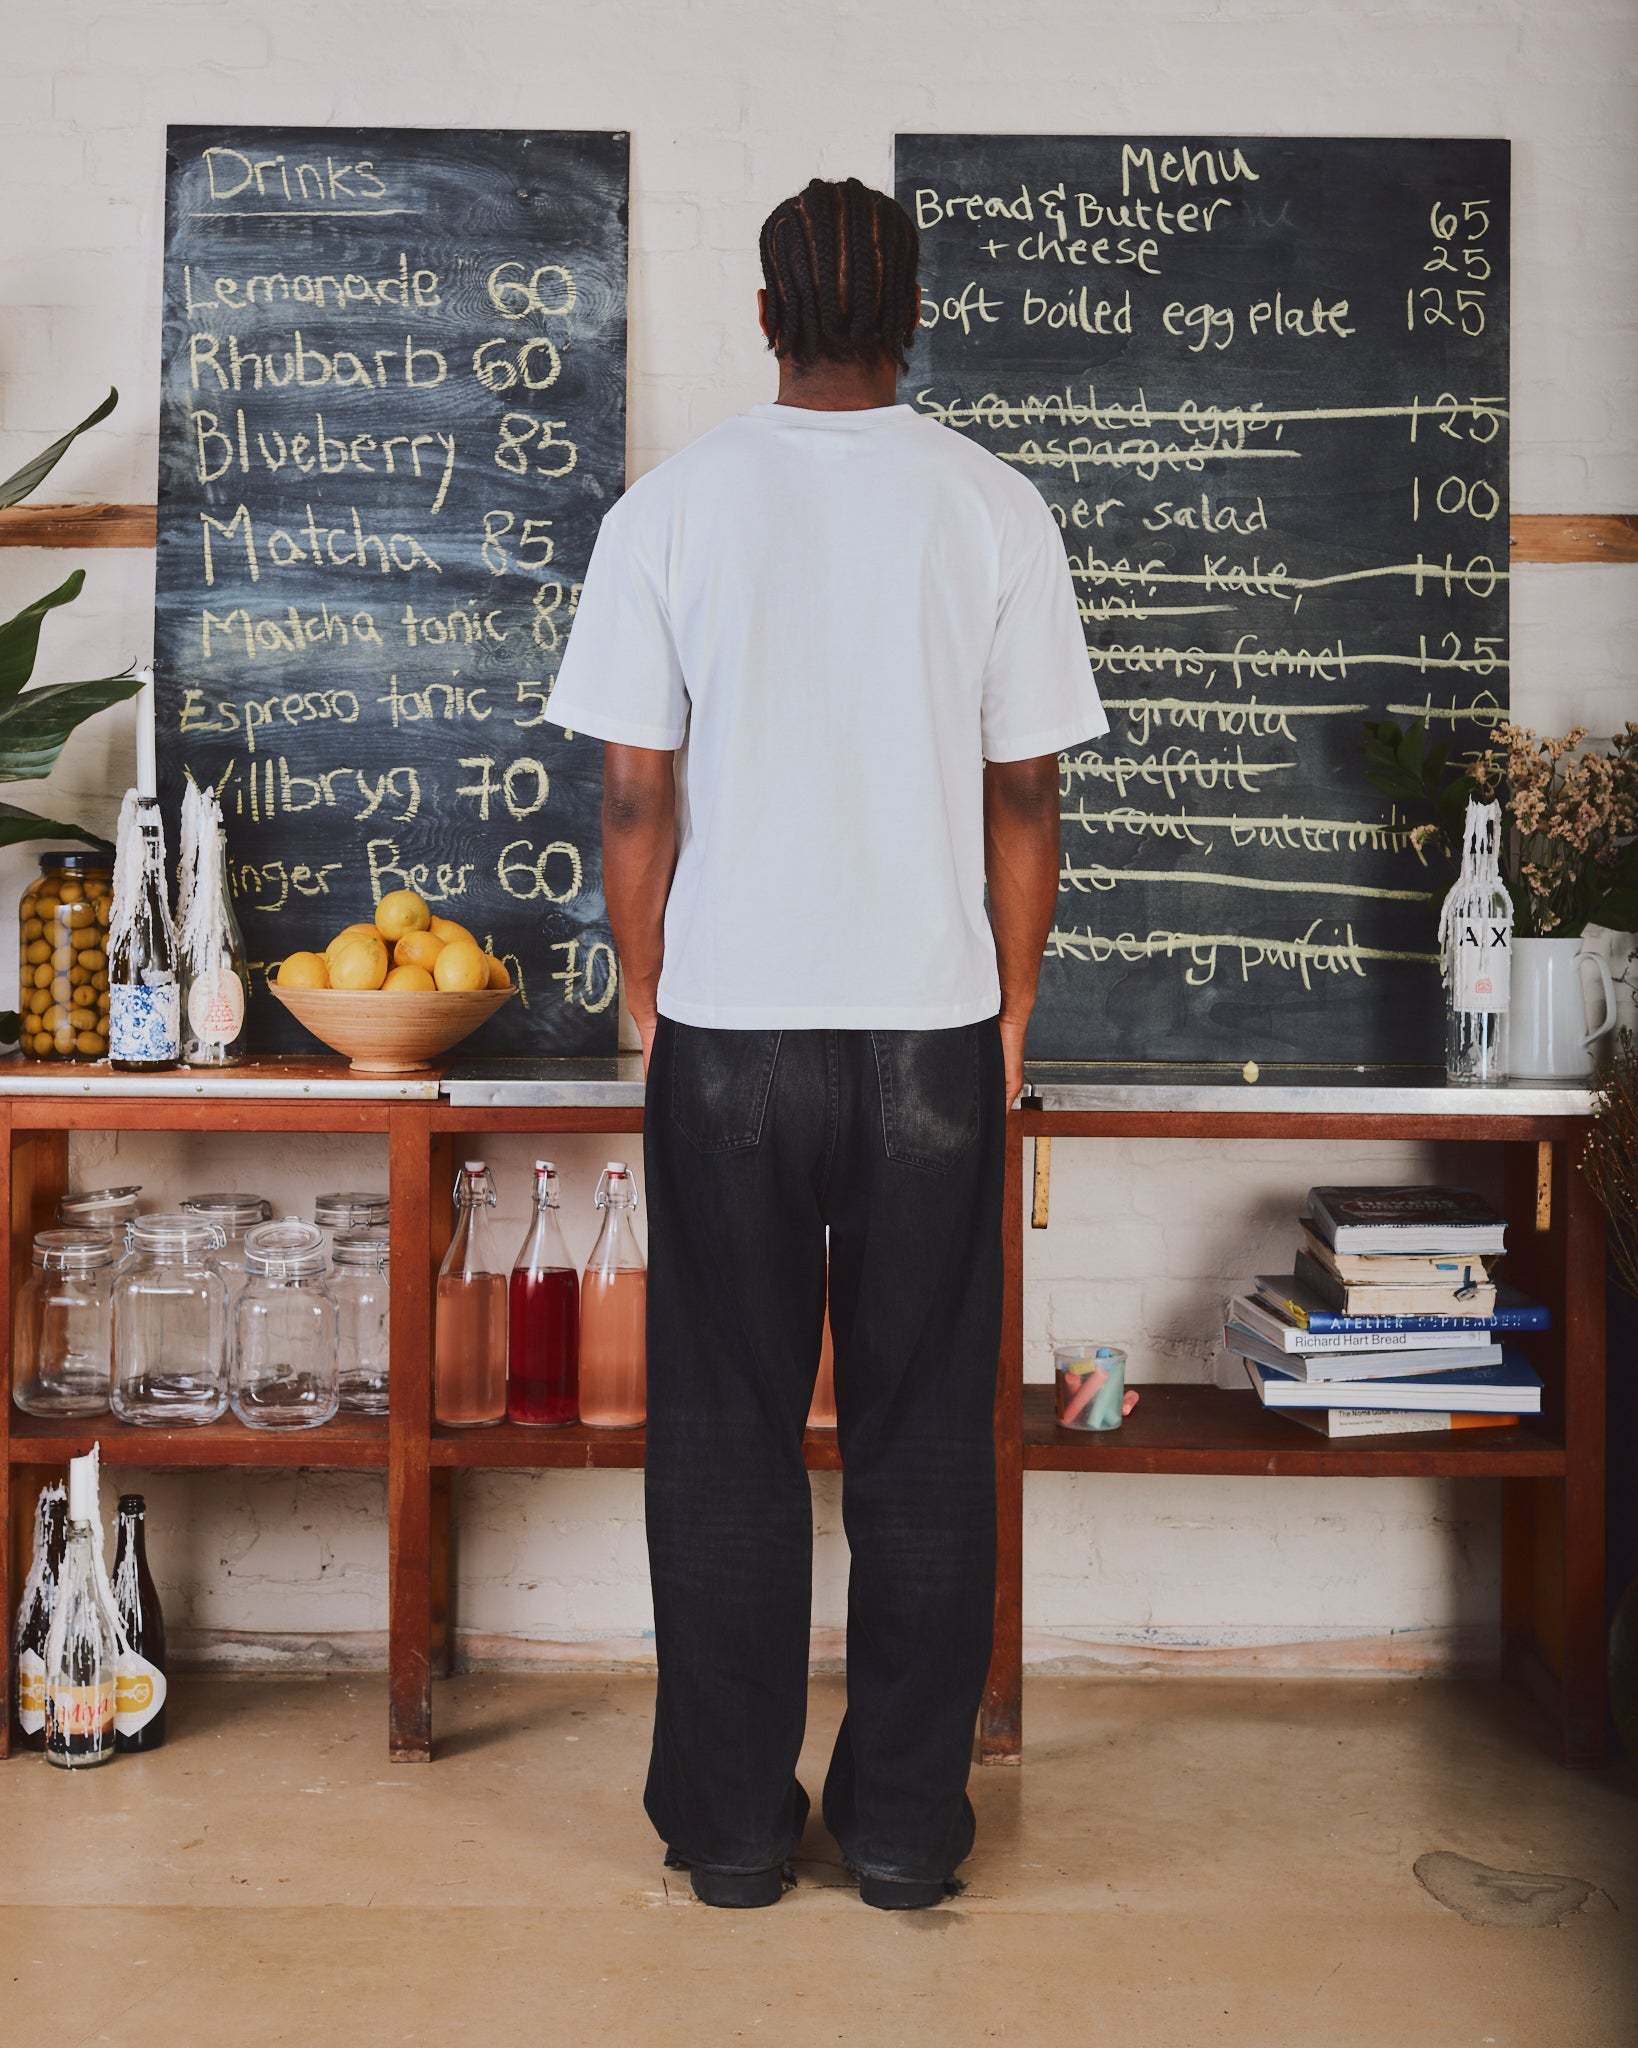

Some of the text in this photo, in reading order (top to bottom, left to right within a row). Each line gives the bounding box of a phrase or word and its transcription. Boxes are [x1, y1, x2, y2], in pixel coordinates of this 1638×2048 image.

[202, 147, 387, 200] Drinks
[1122, 143, 1260, 197] Menu
[915, 185, 1035, 230] Bread
[1075, 192, 1232, 235] Butter
[1430, 200, 1490, 240] 65
[1017, 231, 1162, 275] cheese
[1423, 246, 1491, 281] 25
[185, 252, 577, 320] Lemonade 60
[918, 281, 1487, 353] Soft boiled egg plate 125
[190, 330, 562, 391] Rhubarb 60
[915, 385, 1152, 430] Scrambled
[1410, 392, 1506, 443] 125
[191, 409, 579, 514] Blueberry 85
[1143, 493, 1268, 535] salad
[1412, 476, 1500, 522] 100
[200, 503, 555, 586] Matcha 85
[1415, 553, 1498, 600] 110
[201, 602, 384, 659] Matcha
[401, 599, 509, 647] tonic
[1420, 632, 1505, 675] 125
[179, 687, 361, 753] Espresso
[377, 669, 494, 728] tonic
[456, 753, 551, 822] 70
[228, 838, 583, 912] inger Beer 60
[551, 938, 618, 1014] 70
[1295, 1335, 1341, 1347] Richard
[1344, 1334, 1368, 1346] Hart
[1372, 1333, 1407, 1345] Bread
[1331, 1316, 1404, 1330] ATELIER
